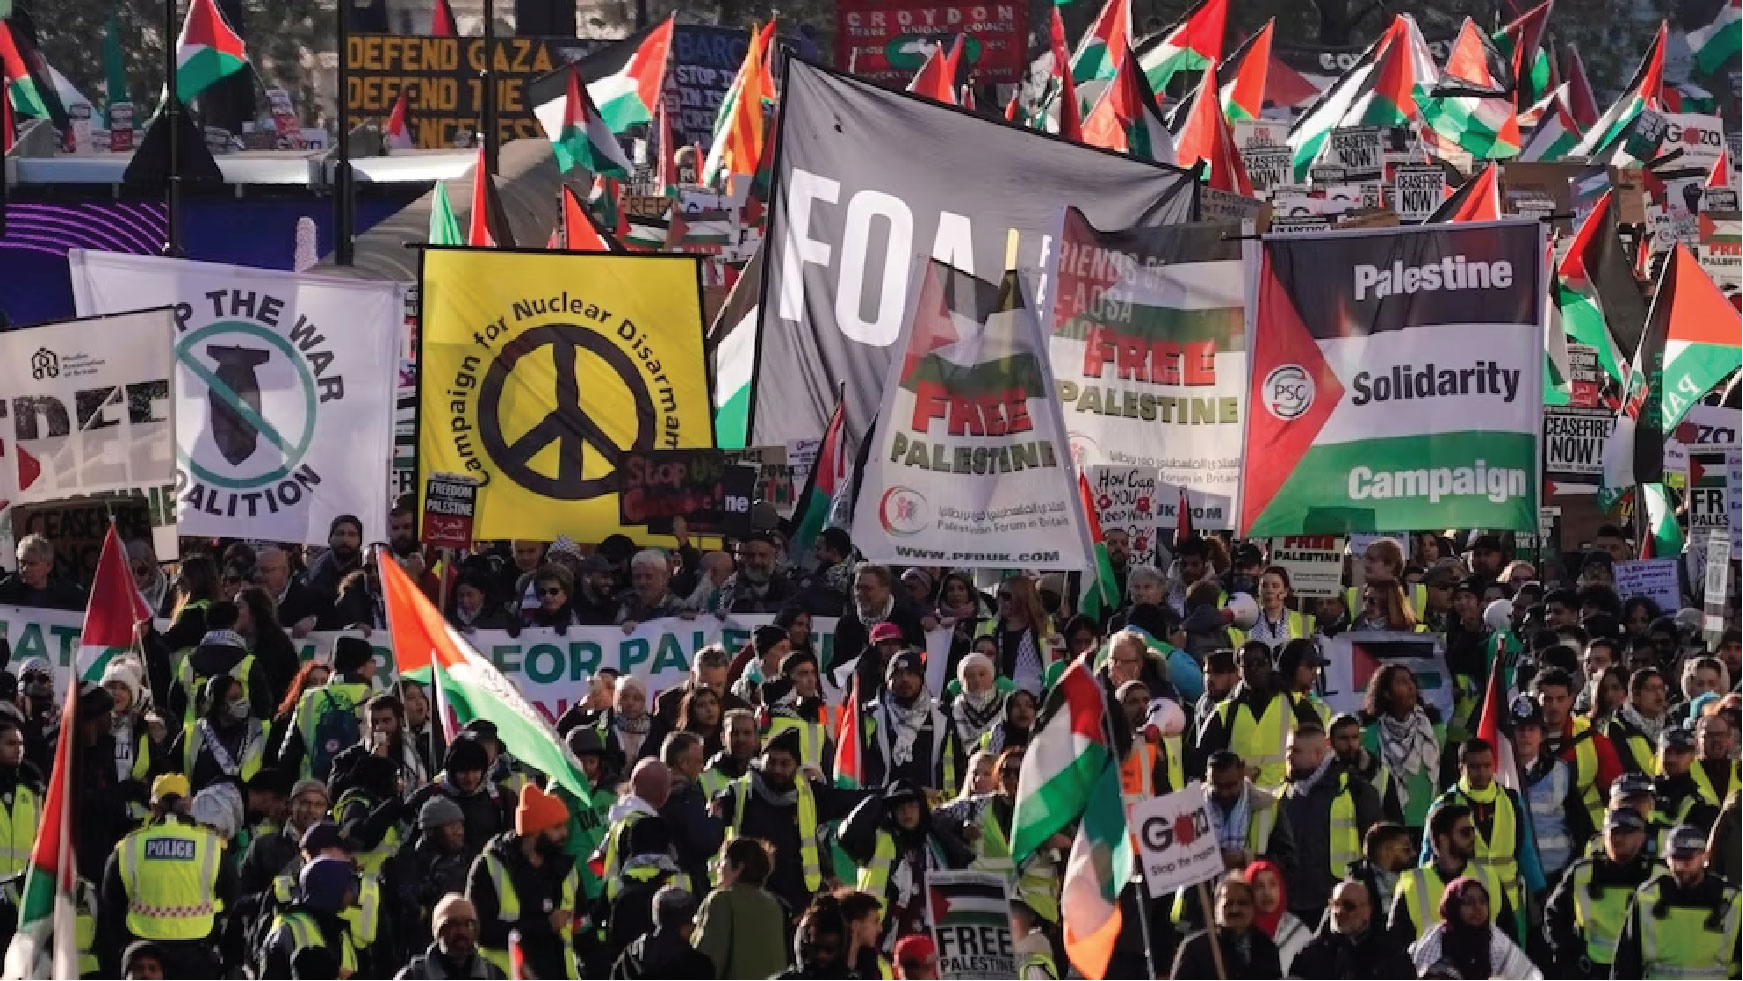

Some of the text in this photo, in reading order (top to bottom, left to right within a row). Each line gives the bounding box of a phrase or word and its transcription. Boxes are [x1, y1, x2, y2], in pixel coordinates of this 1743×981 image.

[847, 5, 1014, 27] CROYDON
[348, 38, 553, 72] DEFEND GAZA
[1332, 134, 1380, 149] CEASEFIRE
[1339, 150, 1378, 167] NOW!
[1398, 173, 1443, 190] CEASEFIRE
[1402, 191, 1440, 212] NOW!
[1353, 255, 1513, 301] Palestine
[205, 289, 285, 328] THE
[289, 313, 345, 404] WAR
[1083, 327, 1217, 387] FREE
[447, 355, 491, 488] Campaign
[473, 316, 509, 350] for
[512, 291, 612, 325] Nuclear
[1274, 384, 1306, 402] PSC
[1351, 361, 1520, 407] Solidarity
[912, 379, 1034, 437] FREE
[1055, 379, 1239, 426] PALESTINE
[1546, 418, 1610, 438] CEASEFIRE
[1551, 437, 1603, 464] NOW!
[430, 482, 473, 498] FREEDOM
[1348, 459, 1526, 504] Campaign
[427, 499, 473, 516] PALESTINE
[724, 494, 749, 513] ne
[1691, 489, 1724, 513] FR
[1275, 550, 1341, 562] PALESTINE
[493, 640, 603, 684] FOR
[147, 840, 194, 858] POLICE
[936, 926, 1014, 957] FREE
[940, 956, 1016, 974] PALESTINE
